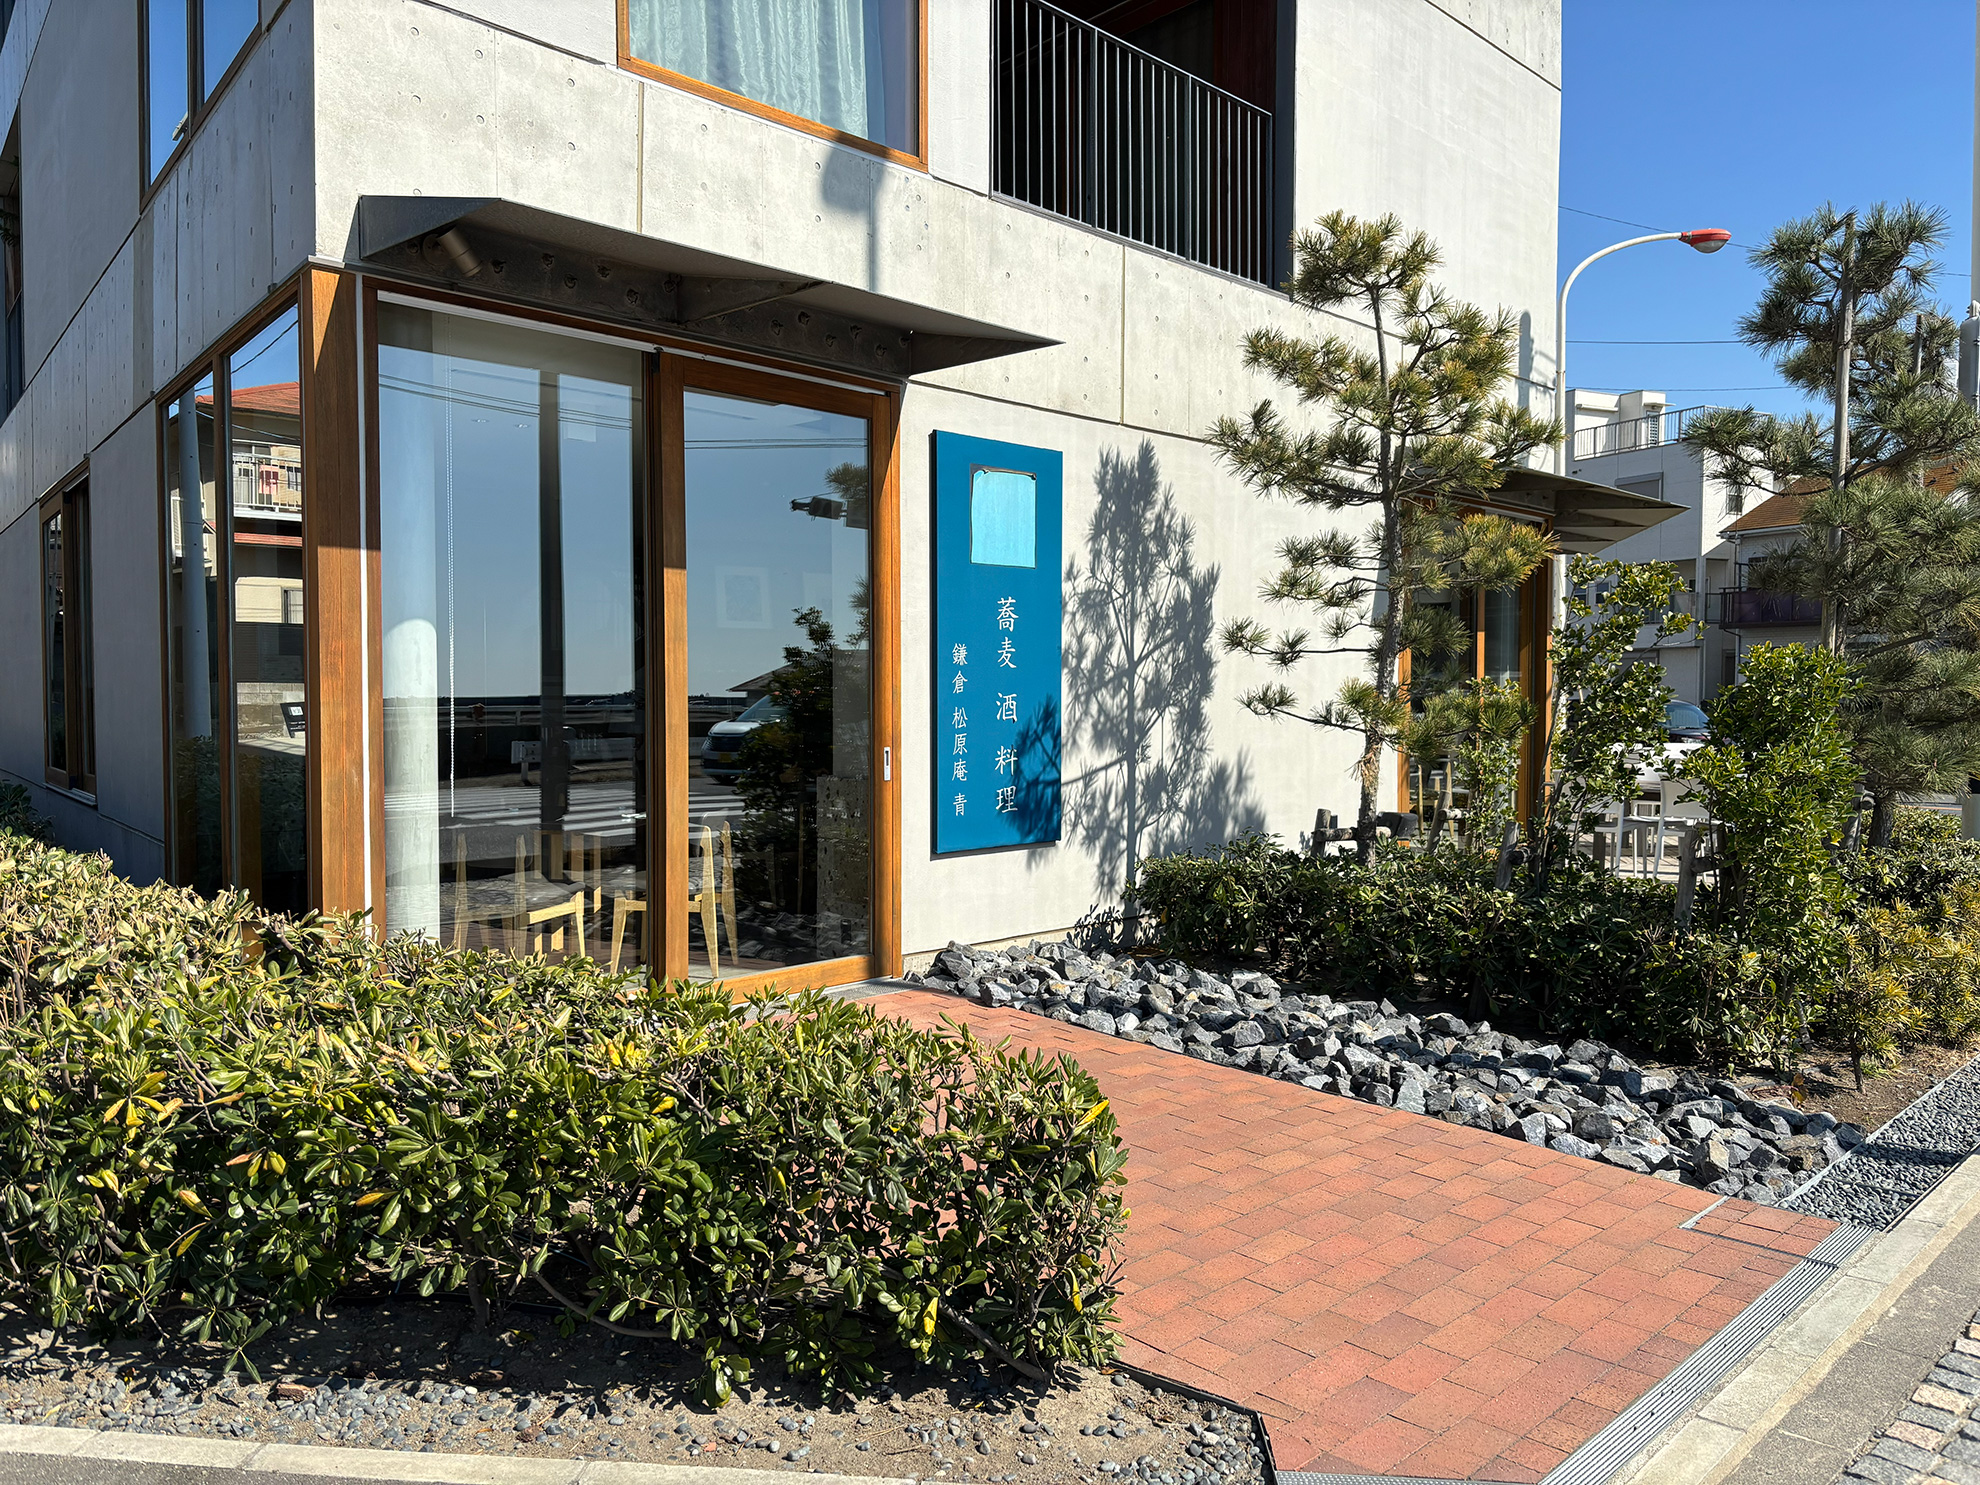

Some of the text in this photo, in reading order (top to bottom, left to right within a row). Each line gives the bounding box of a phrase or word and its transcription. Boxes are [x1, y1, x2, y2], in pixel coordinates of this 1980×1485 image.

[951, 642, 968, 817] 鎌倉 松原庵 青
[994, 596, 1019, 814] 蕎麦 酒 料理
